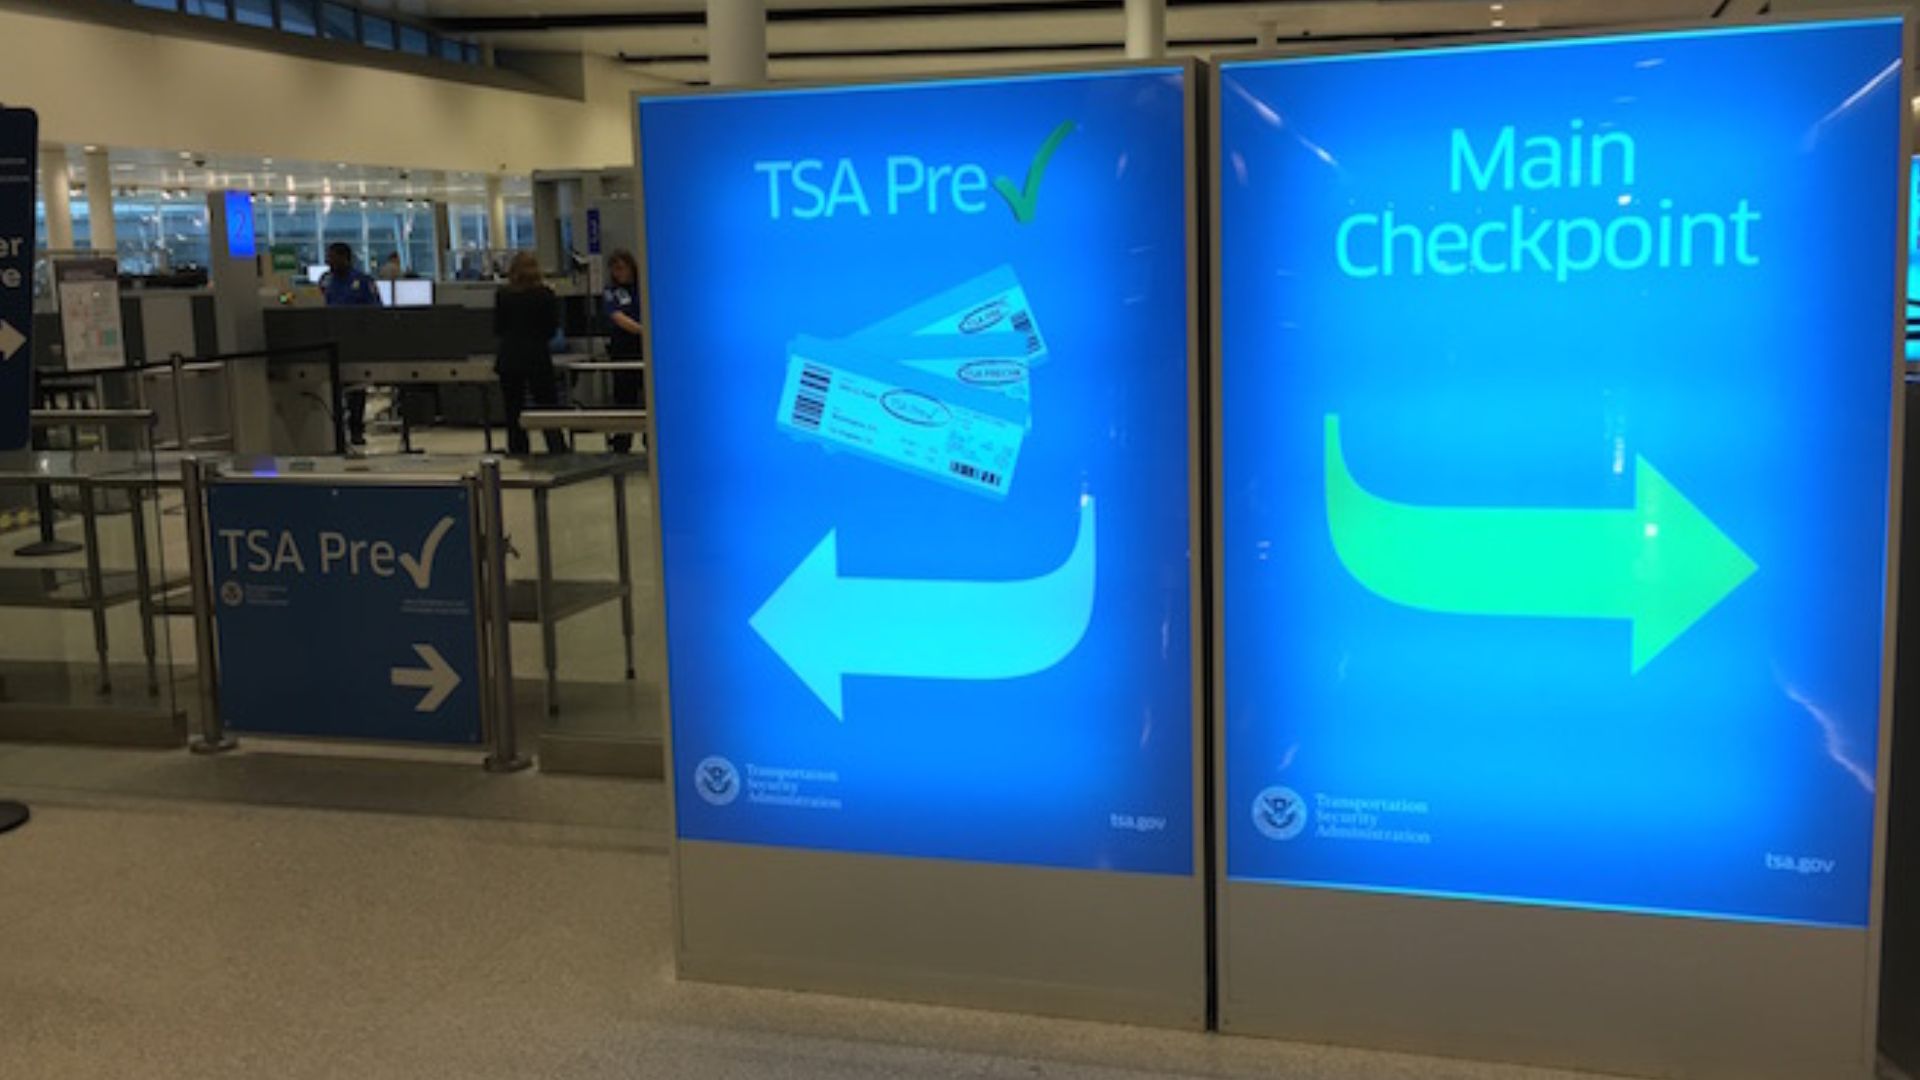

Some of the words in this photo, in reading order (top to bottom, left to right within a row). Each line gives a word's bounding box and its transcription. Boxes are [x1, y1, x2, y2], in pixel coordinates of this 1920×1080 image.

[1449, 118, 1635, 193] Main
[753, 157, 870, 219] TSA
[885, 155, 988, 214] Pre
[1335, 198, 1762, 283] Checkpoint
[218, 528, 305, 573] TSA
[318, 531, 396, 577] Pre
[1314, 792, 1429, 814] Transportation
[1315, 824, 1432, 845] Administration
[1765, 852, 1835, 875] tsa.gov
